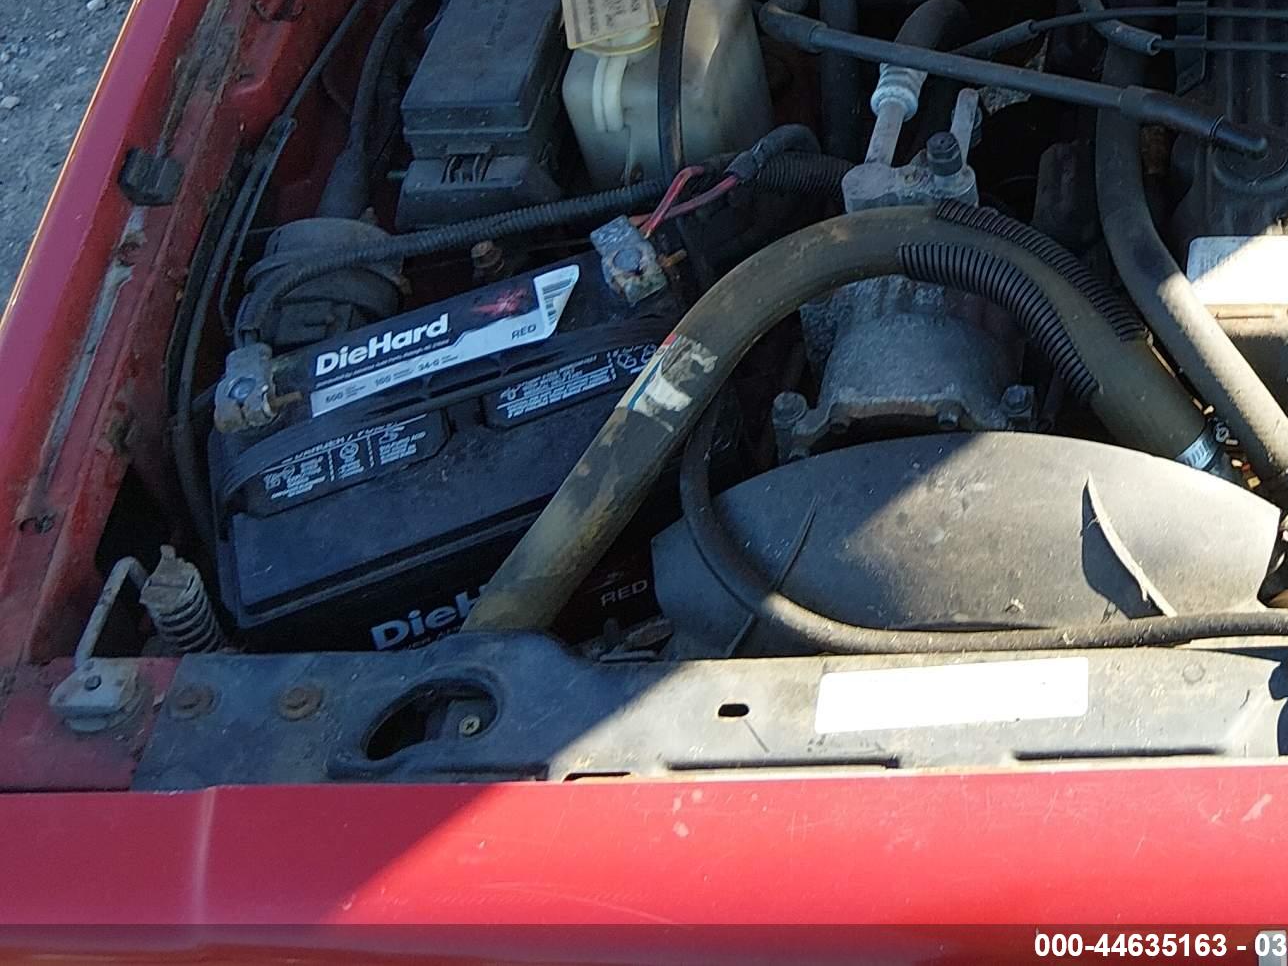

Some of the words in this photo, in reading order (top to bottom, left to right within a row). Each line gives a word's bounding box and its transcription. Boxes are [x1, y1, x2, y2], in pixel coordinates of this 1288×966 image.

[315, 313, 449, 376] DieHard
[511, 324, 537, 340] RED
[601, 579, 648, 607] RED
